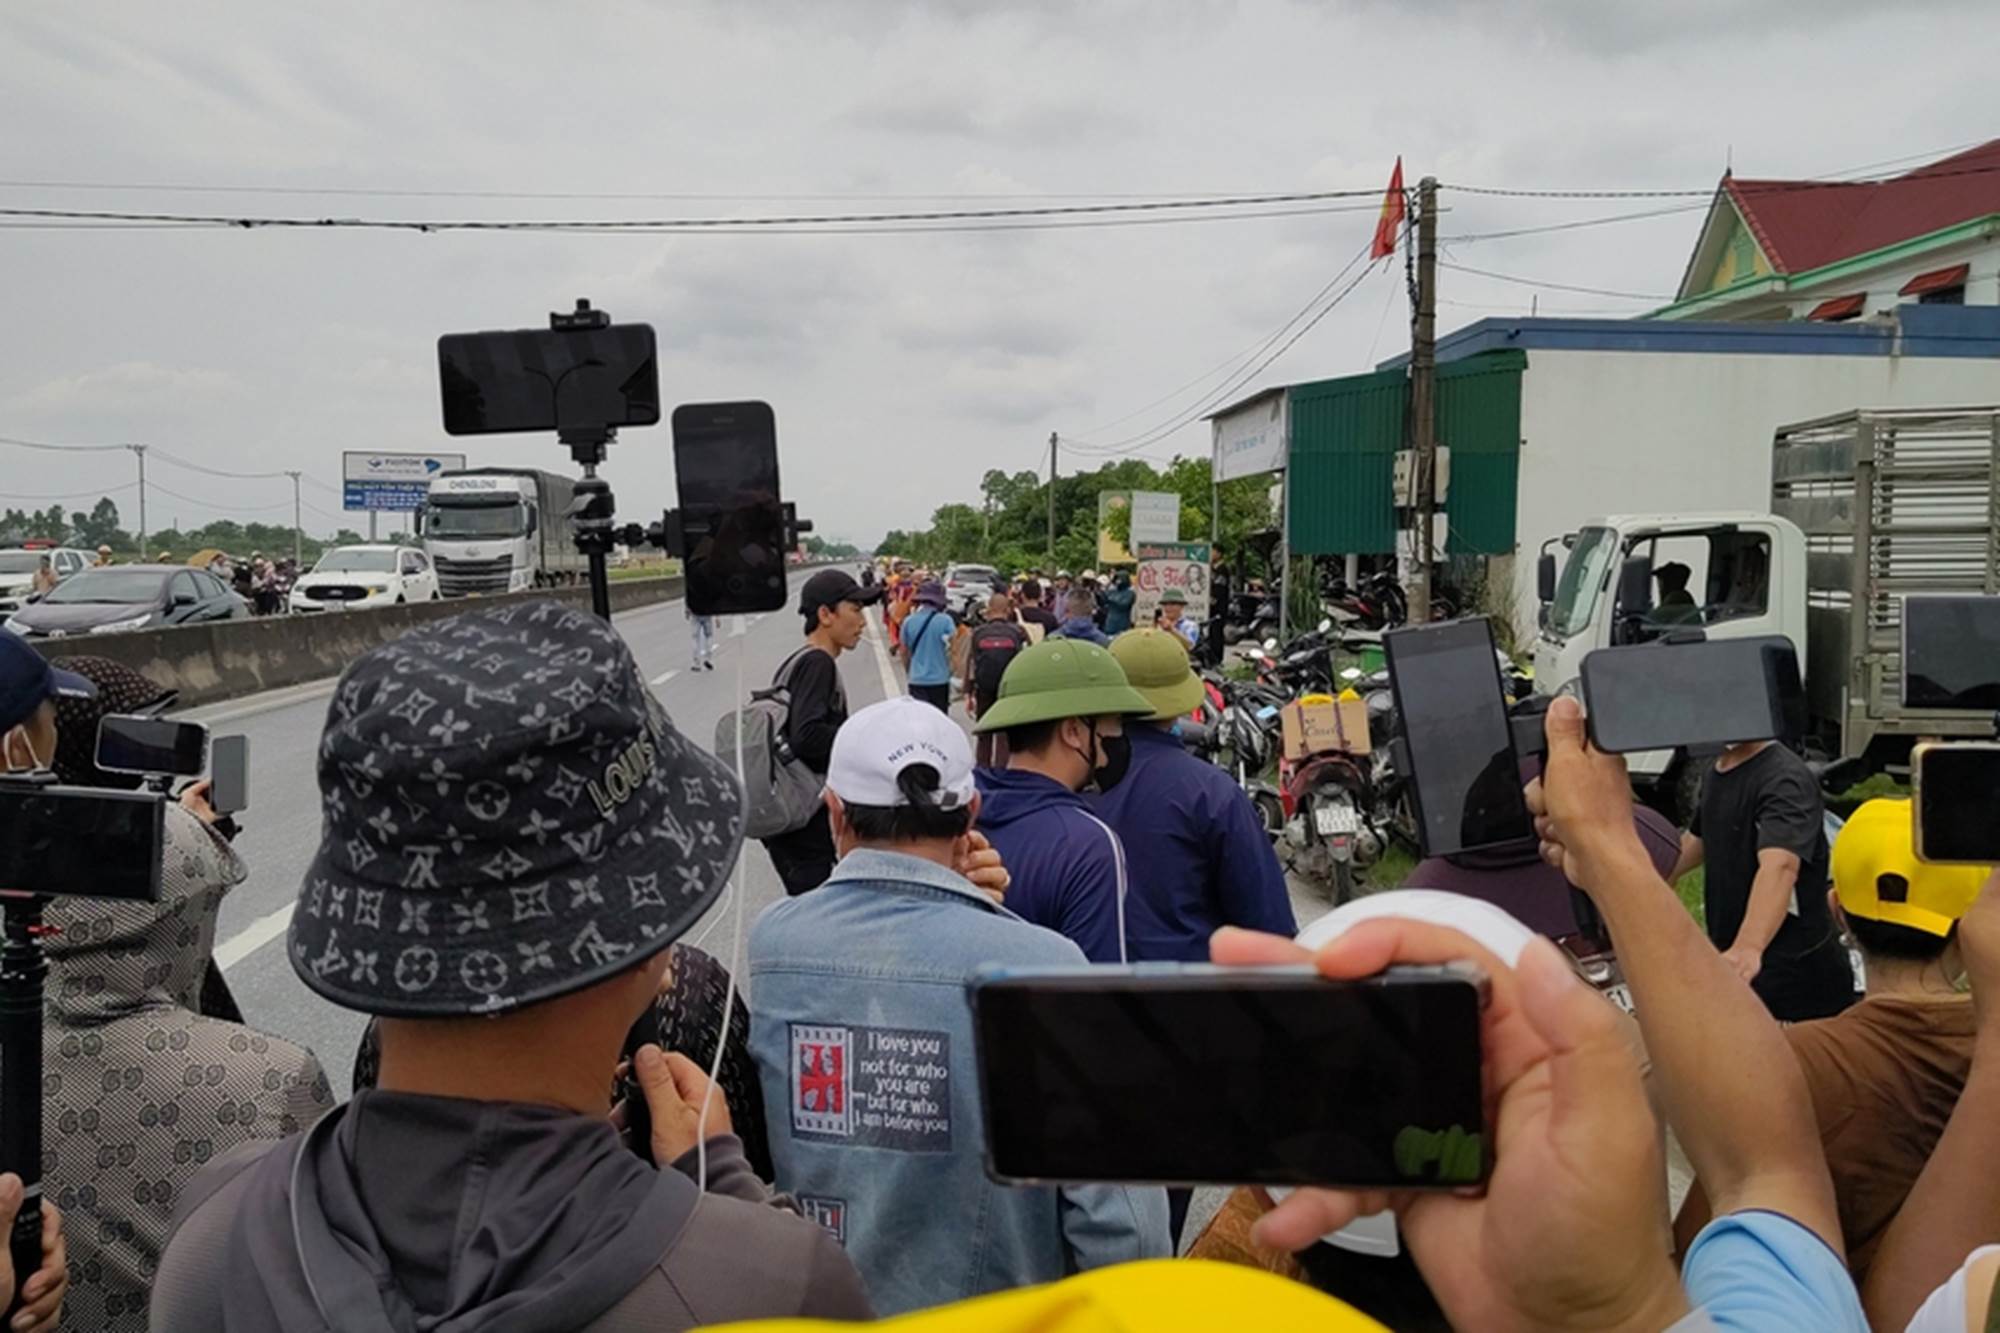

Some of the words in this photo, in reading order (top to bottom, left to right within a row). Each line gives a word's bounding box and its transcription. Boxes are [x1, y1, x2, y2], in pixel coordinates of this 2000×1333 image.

[449, 480, 497, 490] CHENGLONG
[887, 743, 915, 764] NEW
[919, 741, 949, 762] YORK
[586, 731, 655, 817] LOUIS
[878, 1033, 909, 1053] love
[910, 1038, 940, 1057] you
[860, 1060, 885, 1074] not
[889, 1059, 911, 1075] for
[915, 1061, 947, 1079] who
[875, 1077, 902, 1094] you
[905, 1080, 930, 1095] are
[867, 1092, 888, 1109] but
[890, 1094, 907, 1113] for
[911, 1097, 939, 1114] who
[863, 1112, 882, 1126] am
[884, 1111, 922, 1128] before
[923, 1118, 948, 1134] you
